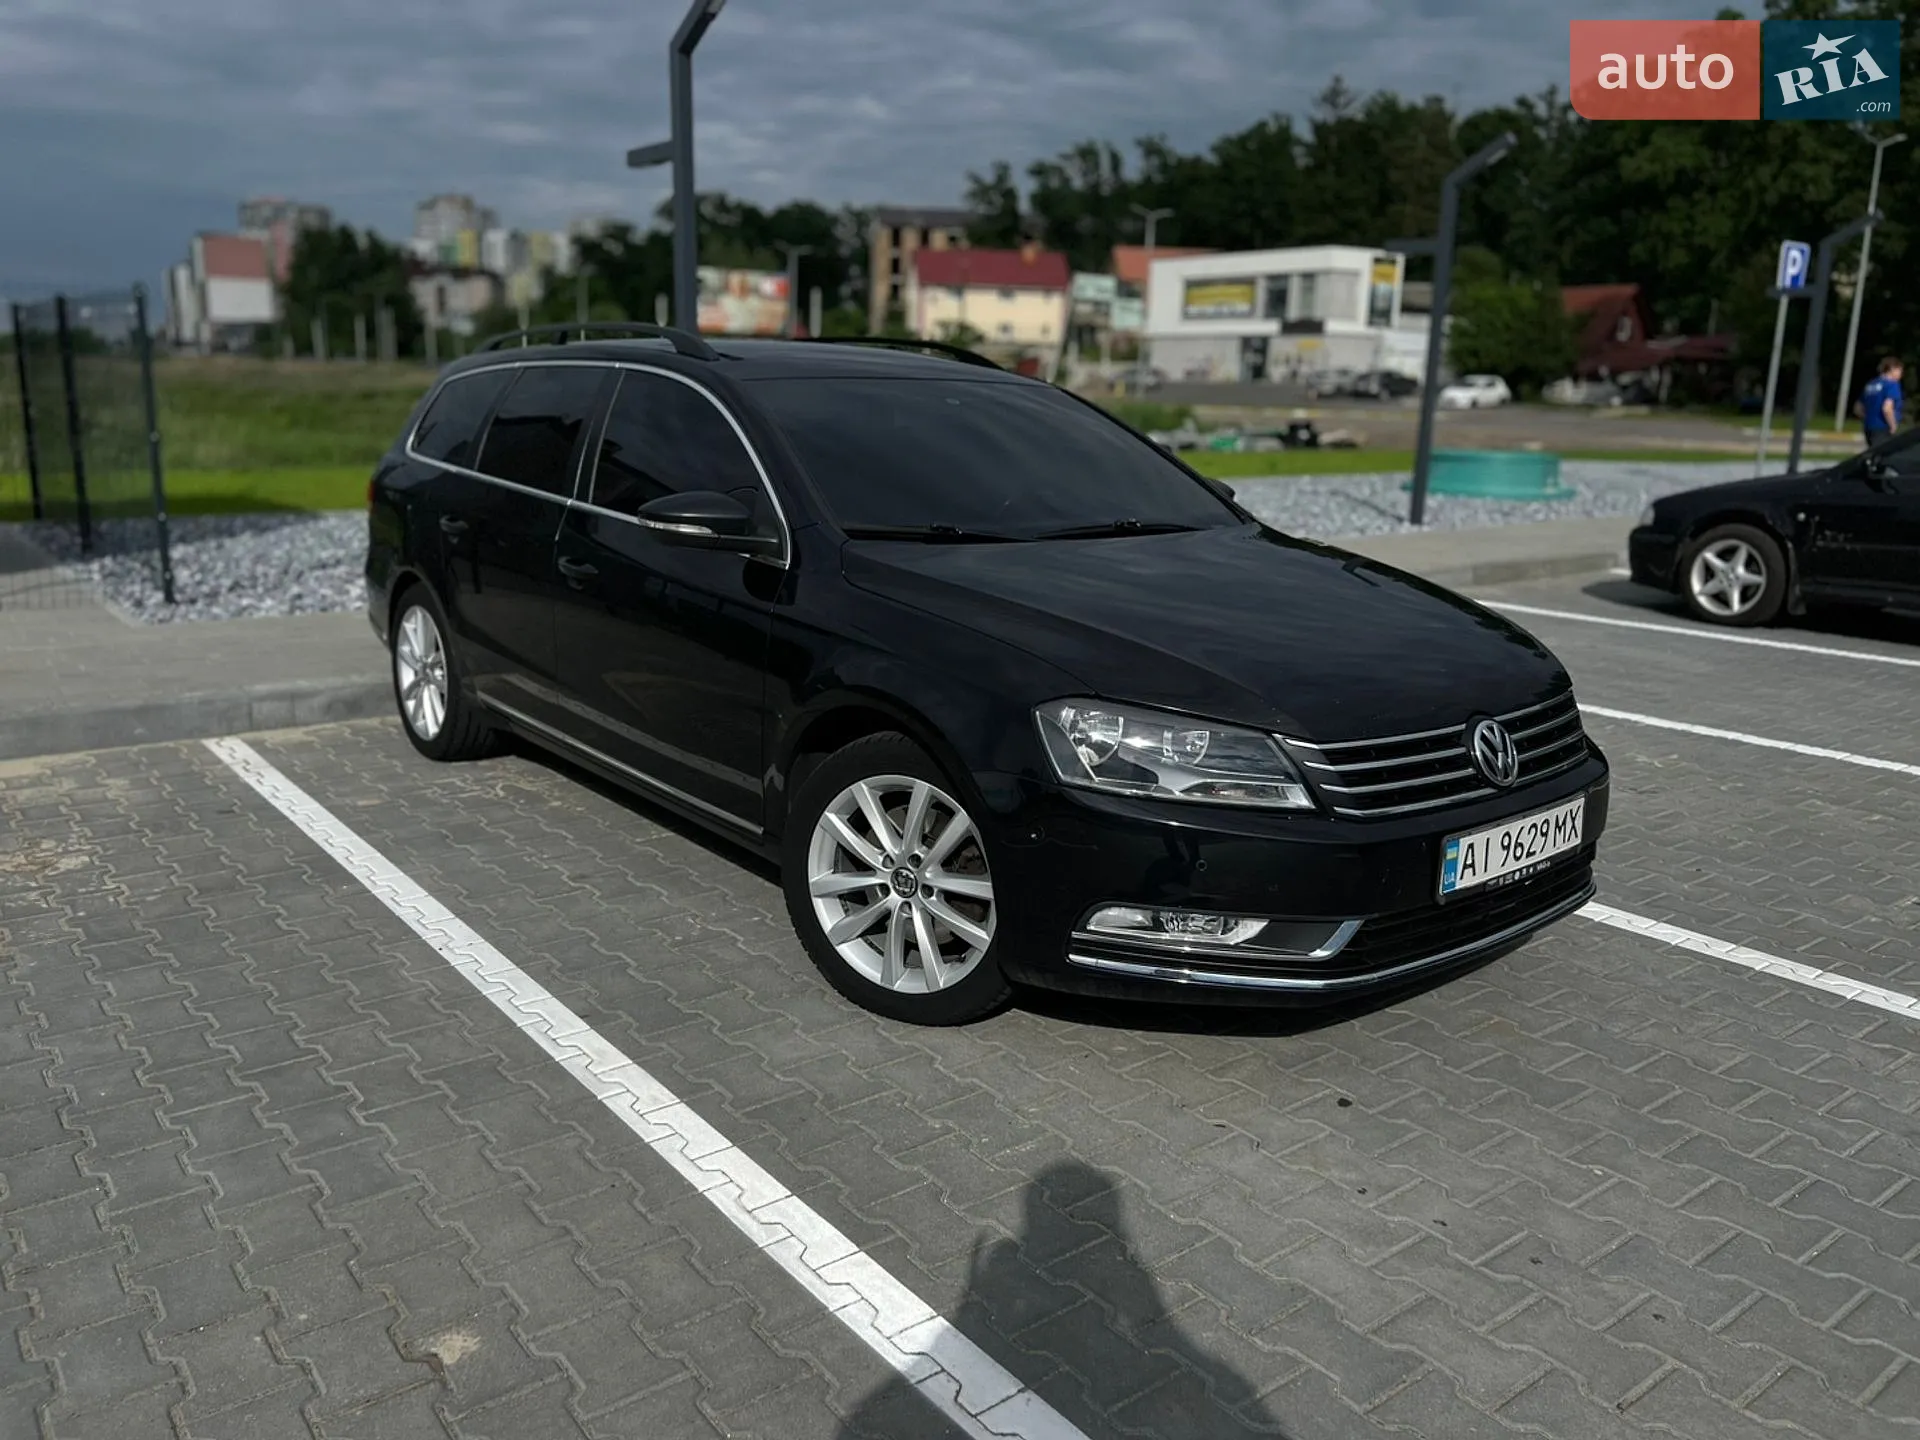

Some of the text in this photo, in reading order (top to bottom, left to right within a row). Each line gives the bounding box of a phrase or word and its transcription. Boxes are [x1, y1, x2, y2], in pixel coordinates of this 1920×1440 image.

[1785, 249, 1802, 287] P
[1459, 805, 1581, 880] AI 9629 MX
